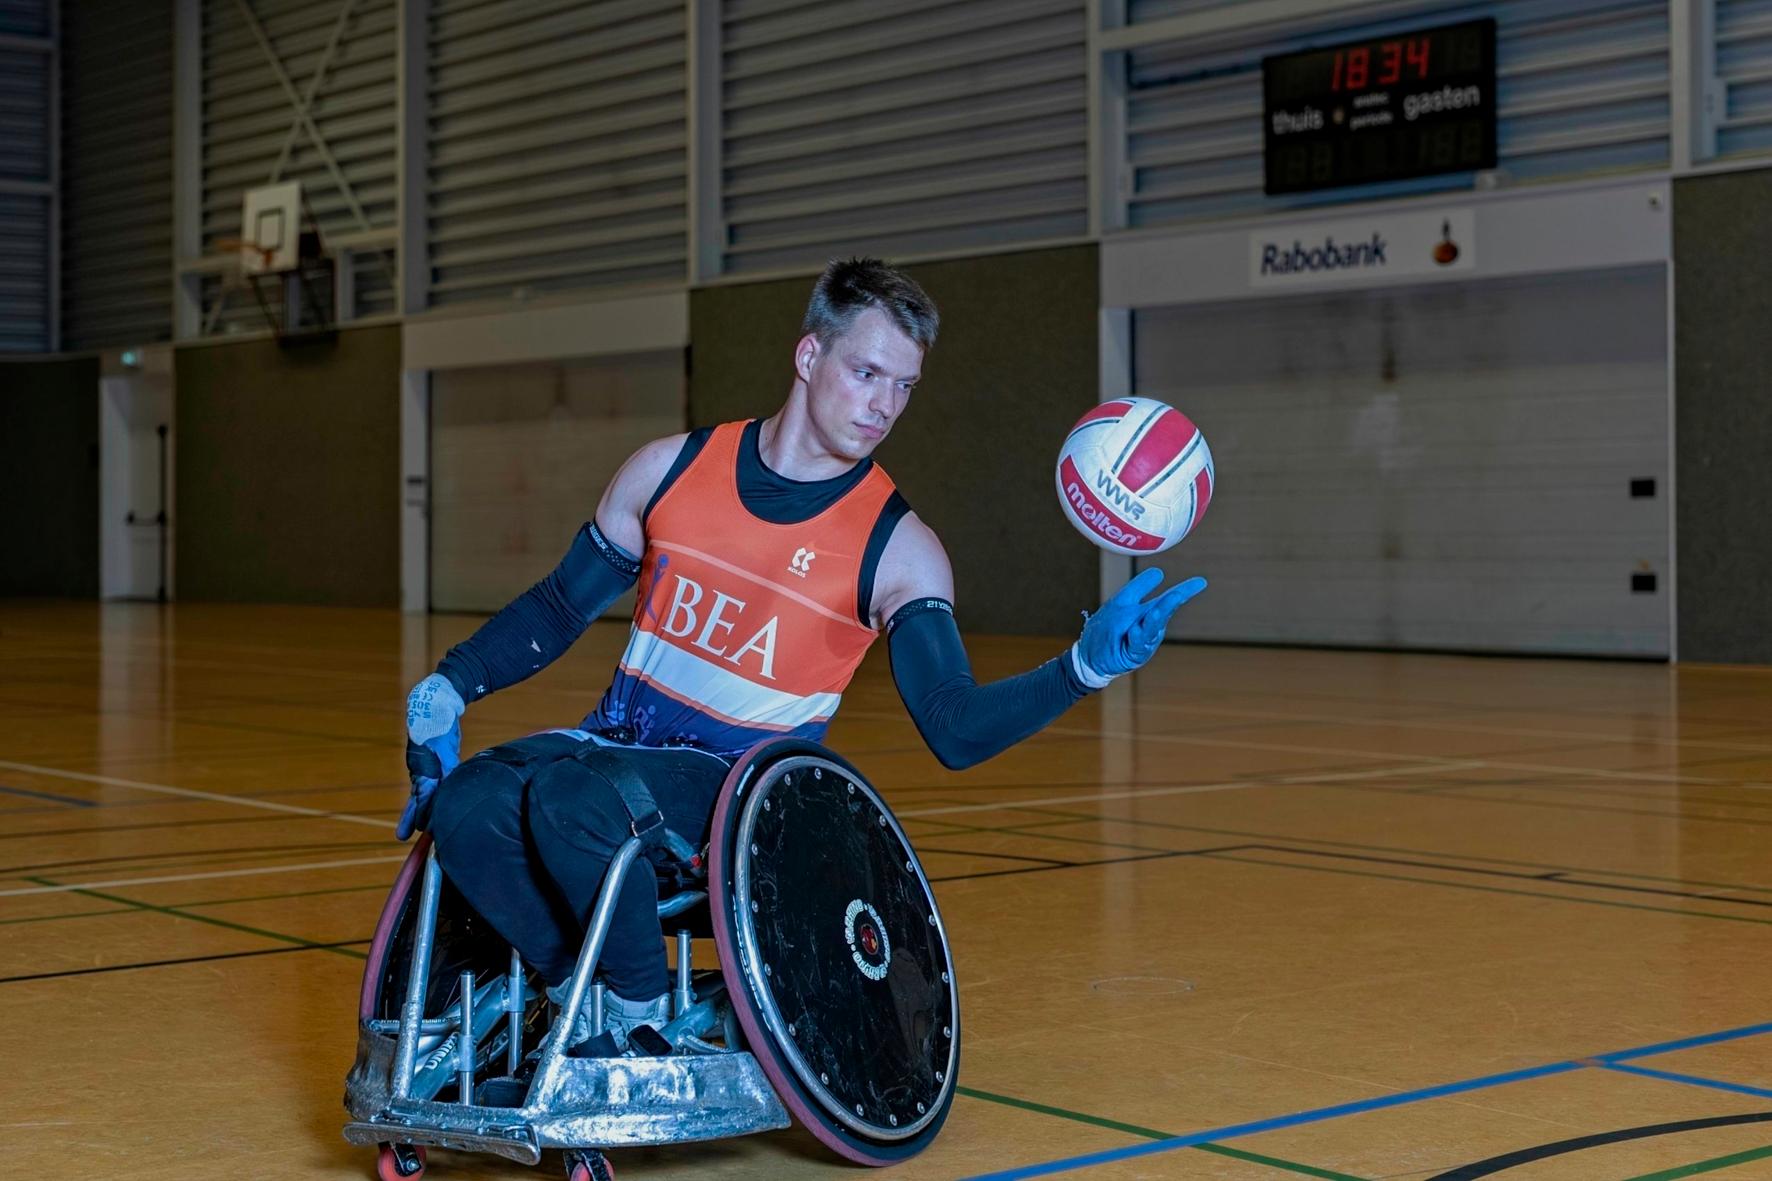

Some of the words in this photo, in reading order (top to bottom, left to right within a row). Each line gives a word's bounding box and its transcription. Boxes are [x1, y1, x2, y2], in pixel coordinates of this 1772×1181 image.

[1272, 107, 1324, 135] thuis
[1403, 85, 1480, 121] gasten
[1261, 231, 1386, 275] Rabobank
[1067, 482, 1138, 547] molten
[661, 574, 779, 681] BEA
